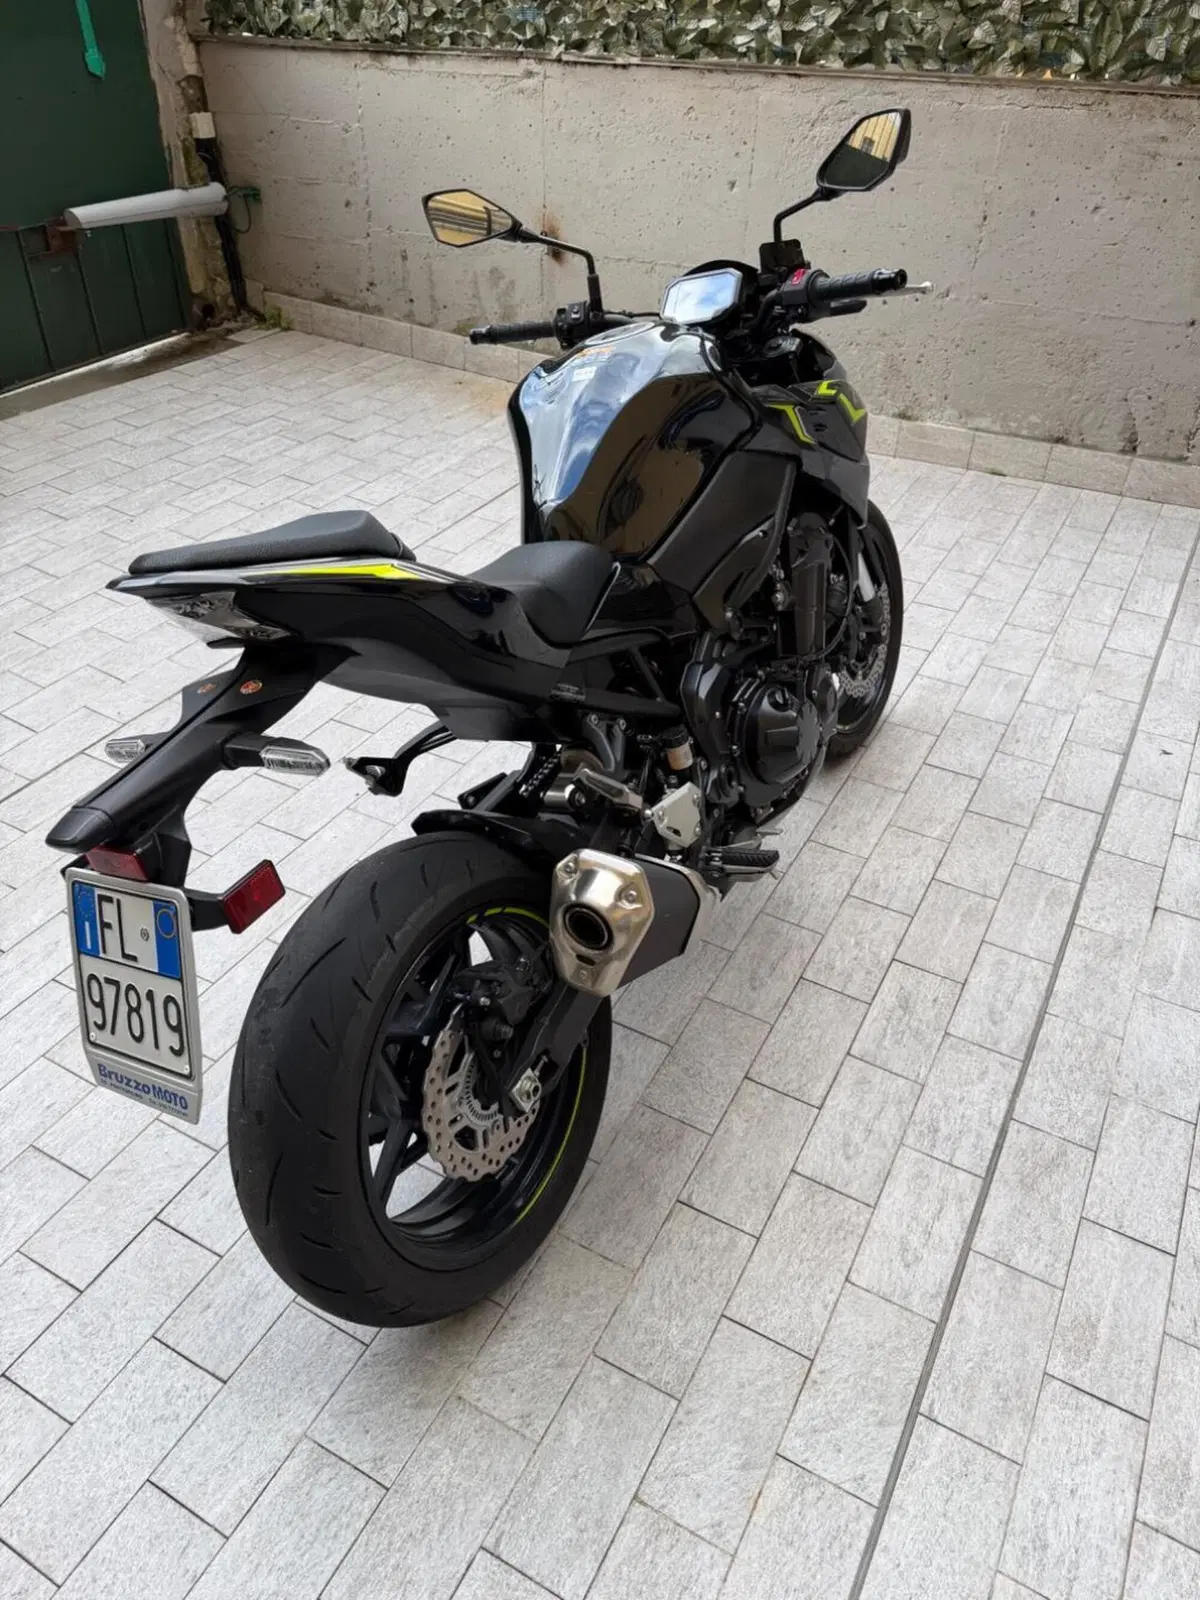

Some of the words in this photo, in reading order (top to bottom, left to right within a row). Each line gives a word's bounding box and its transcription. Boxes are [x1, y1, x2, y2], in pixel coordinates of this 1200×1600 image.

[84, 920, 92, 950] I
[97, 893, 138, 962] FL
[86, 973, 186, 1057] 97819
